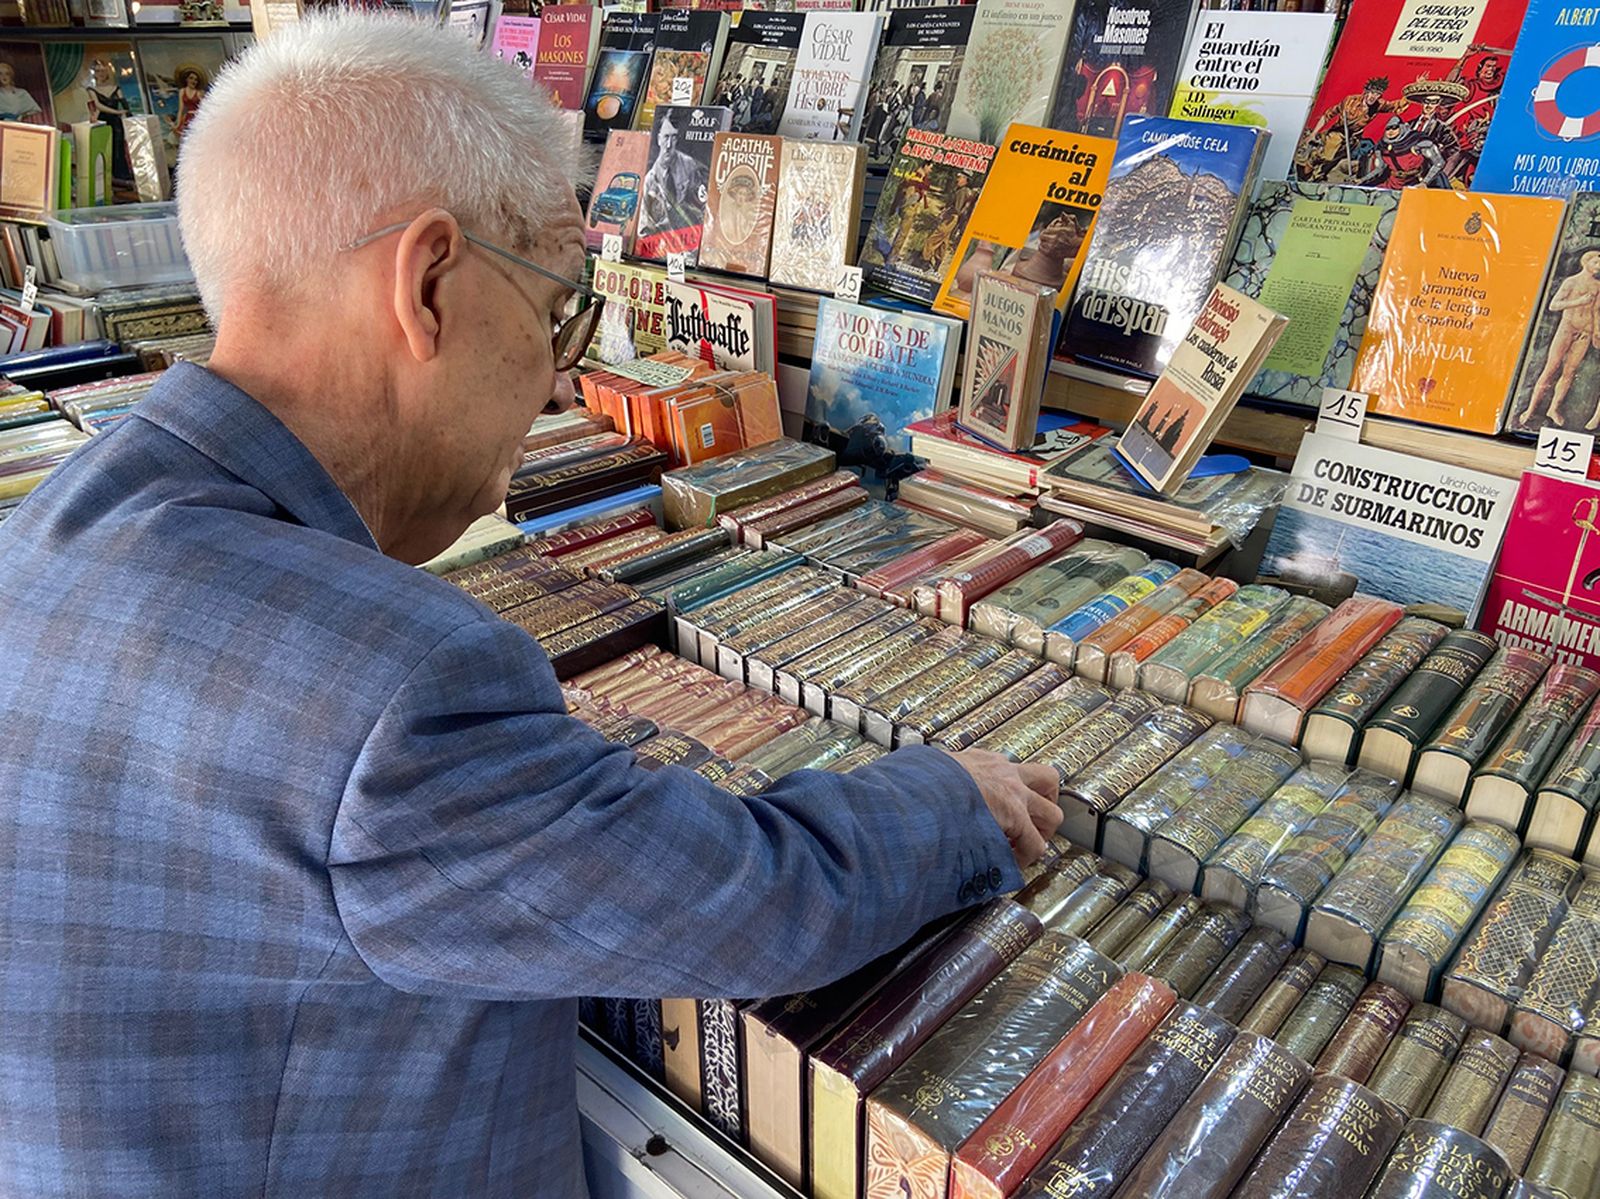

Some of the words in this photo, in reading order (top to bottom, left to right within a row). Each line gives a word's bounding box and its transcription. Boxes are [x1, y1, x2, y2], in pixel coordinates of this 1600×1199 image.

[566, 13, 587, 24] VIDAL
[982, 10, 990, 18] El
[990, 10, 1018, 19] infinito
[1018, 12, 1028, 20] en
[1040, 12, 1064, 22] junco
[1106, 7, 1152, 27] Nosotros,
[1415, 5, 1474, 20] CATALOGO
[1555, 8, 1600, 26] ALBERT
[812, 23, 854, 44] CÉSAR
[1103, 25, 1150, 44] Masones
[1204, 22, 1224, 38] El
[1407, 18, 1430, 28] DEL
[1429, 18, 1468, 30] TEBEO
[554, 33, 572, 48] LOS
[1398, 30, 1418, 40] EN
[1416, 30, 1464, 43] ESPAÑA
[538, 50, 584, 64] MASONES
[812, 44, 851, 62] VIDAL
[1199, 38, 1280, 59] guardián
[1195, 56, 1241, 73] entre
[1244, 57, 1262, 74] el
[796, 80, 848, 97] CUMBRE
[1190, 73, 1260, 91] centeno
[1184, 92, 1206, 104] J.D.
[689, 117, 717, 128] ADOLF
[1180, 104, 1238, 122] Salinger
[685, 130, 715, 142] HITLER
[723, 138, 774, 154] AGATHA
[906, 128, 945, 148] MANUAL
[954, 138, 996, 160] CAZADOR
[1204, 138, 1228, 152] CELA
[827, 151, 848, 164] DEL
[910, 144, 935, 160] AVES
[943, 152, 989, 174] MONTAÑA
[1010, 138, 1098, 168] cerámica
[716, 152, 774, 186] CHRISTIE
[1514, 154, 1536, 172] MIS
[1538, 156, 1563, 174] DOS
[1564, 158, 1600, 178] LIBRO
[1068, 168, 1089, 186] al
[1046, 182, 1102, 208] torno
[1323, 218, 1360, 228] PRIVADAS
[838, 271, 858, 292] 15
[1438, 266, 1480, 282] Nueva
[1422, 282, 1488, 300] gramática
[984, 292, 1026, 318] JUEGOS
[1099, 294, 1171, 337] Españ
[1410, 296, 1426, 308] de
[1430, 296, 1442, 310] la
[1445, 299, 1491, 318] lengua
[666, 296, 750, 358] Luftwaffe
[834, 311, 903, 344] AVIONES
[906, 328, 931, 350] DE
[982, 309, 1022, 336] MANOS
[1417, 313, 1474, 331] española
[838, 332, 919, 368] COMBATE
[1186, 326, 1200, 346] Los
[1226, 356, 1238, 373] de
[1404, 340, 1476, 364] MANUAL
[1200, 360, 1226, 392] Rusia
[1326, 394, 1358, 420] 15
[1541, 436, 1581, 462] 15
[1314, 458, 1496, 521] CONSTRUCCION
[1440, 474, 1468, 489] Ulrich
[1466, 481, 1500, 498] Gabler
[1296, 484, 1326, 508] DE
[1330, 492, 1484, 550] SUBMARINOS
[1169, 1020, 1216, 1052] WILDE
[1178, 1016, 1218, 1041] OSCAR
[1150, 1034, 1208, 1072] COMPLETAS
[1168, 1030, 1206, 1056] OBRAS
